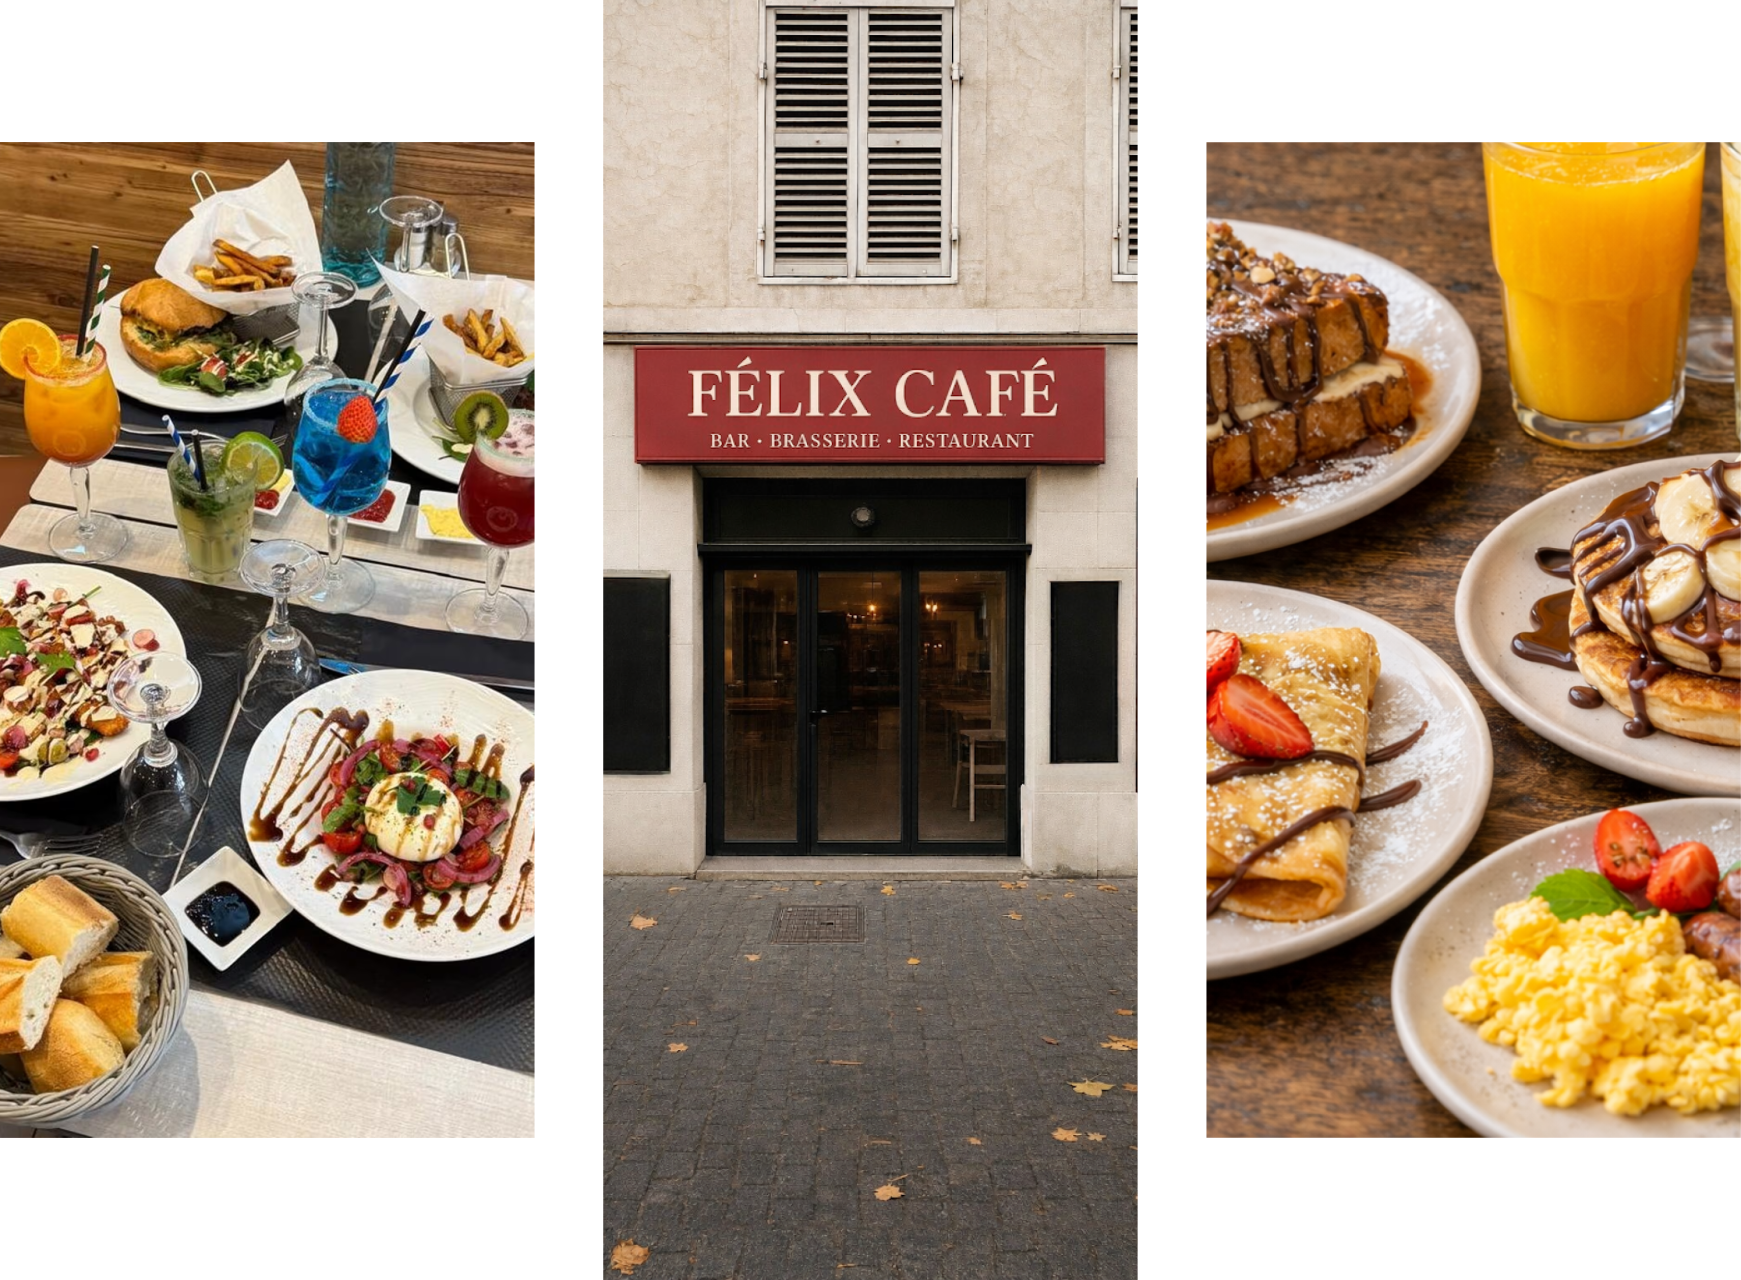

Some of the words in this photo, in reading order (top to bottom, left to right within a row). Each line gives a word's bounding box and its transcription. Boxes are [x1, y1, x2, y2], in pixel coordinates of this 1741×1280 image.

[687, 356, 872, 417] FÉLIX
[895, 356, 1058, 418] CAFÉ
[710, 433, 750, 448] BAR
[770, 433, 880, 448] BRASSERIE
[899, 433, 1034, 448] RESTAURANT
